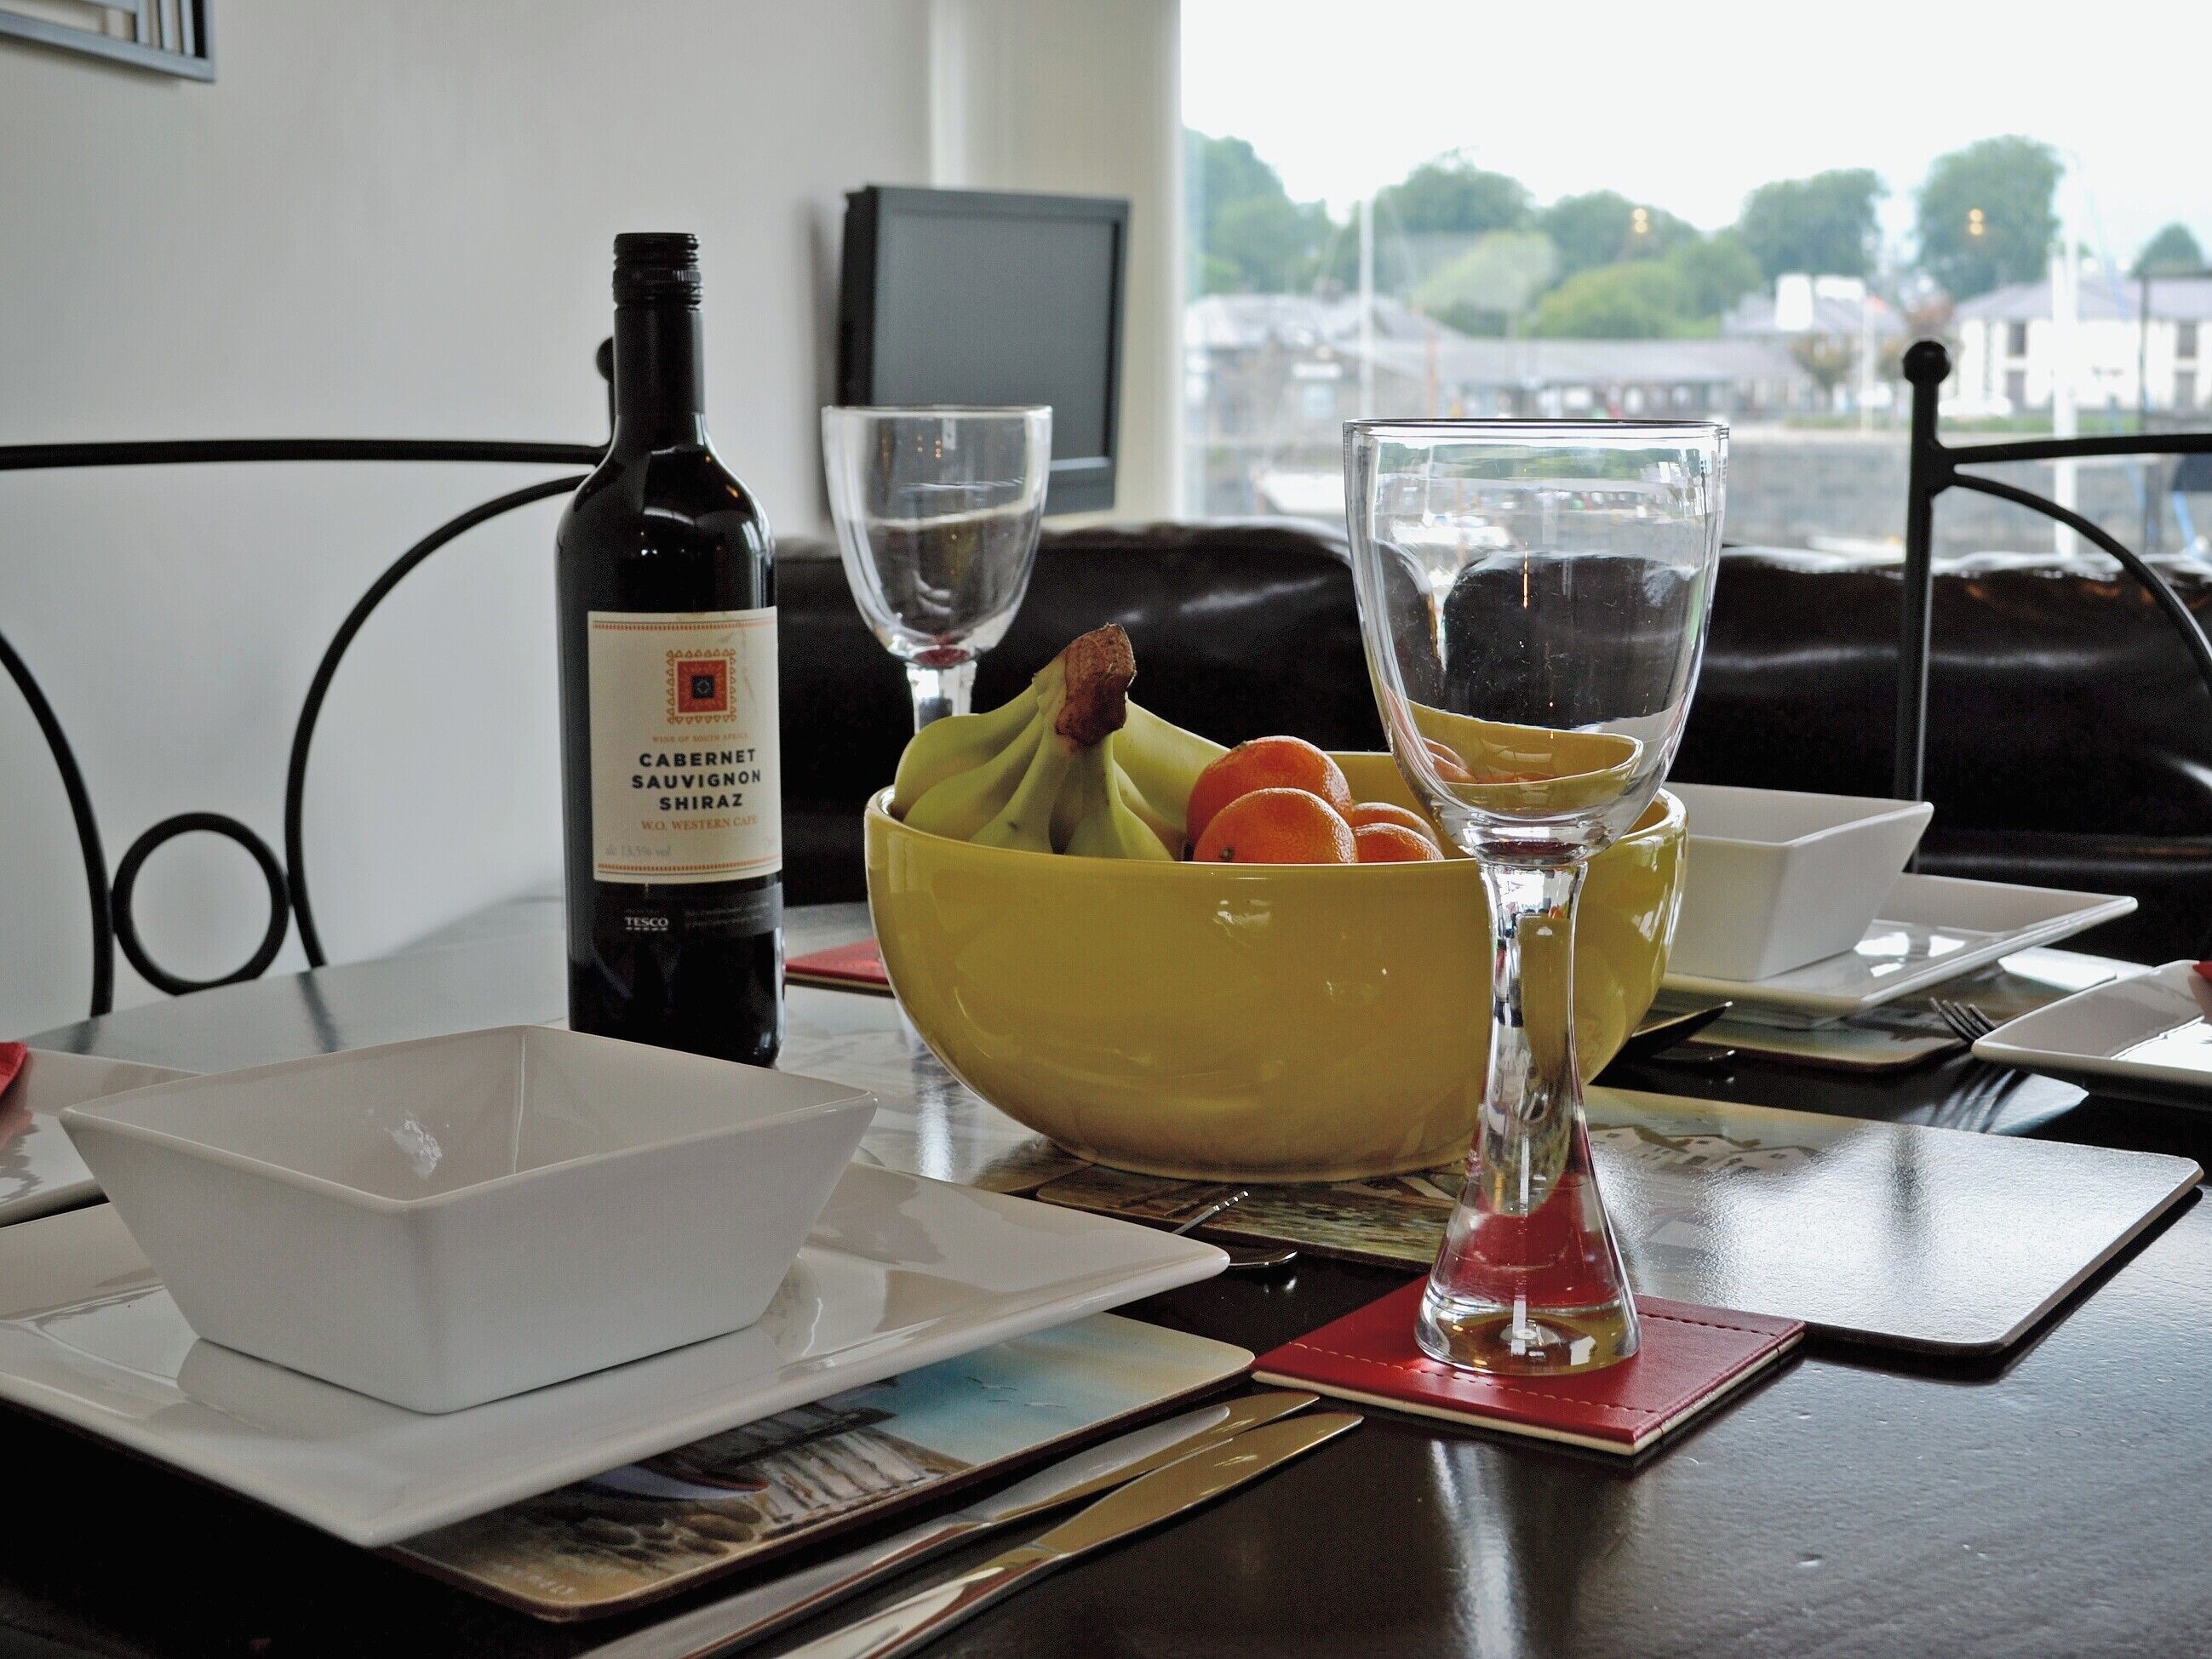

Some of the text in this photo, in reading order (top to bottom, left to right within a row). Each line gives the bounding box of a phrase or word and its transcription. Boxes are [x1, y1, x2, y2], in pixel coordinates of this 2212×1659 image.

[639, 748, 756, 768] CABERNET
[632, 769, 761, 789] SAUVIGNON
[659, 793, 743, 810] SHIRAZ
[671, 818, 731, 830] WESTERN
[624, 917, 668, 927] TESCO
